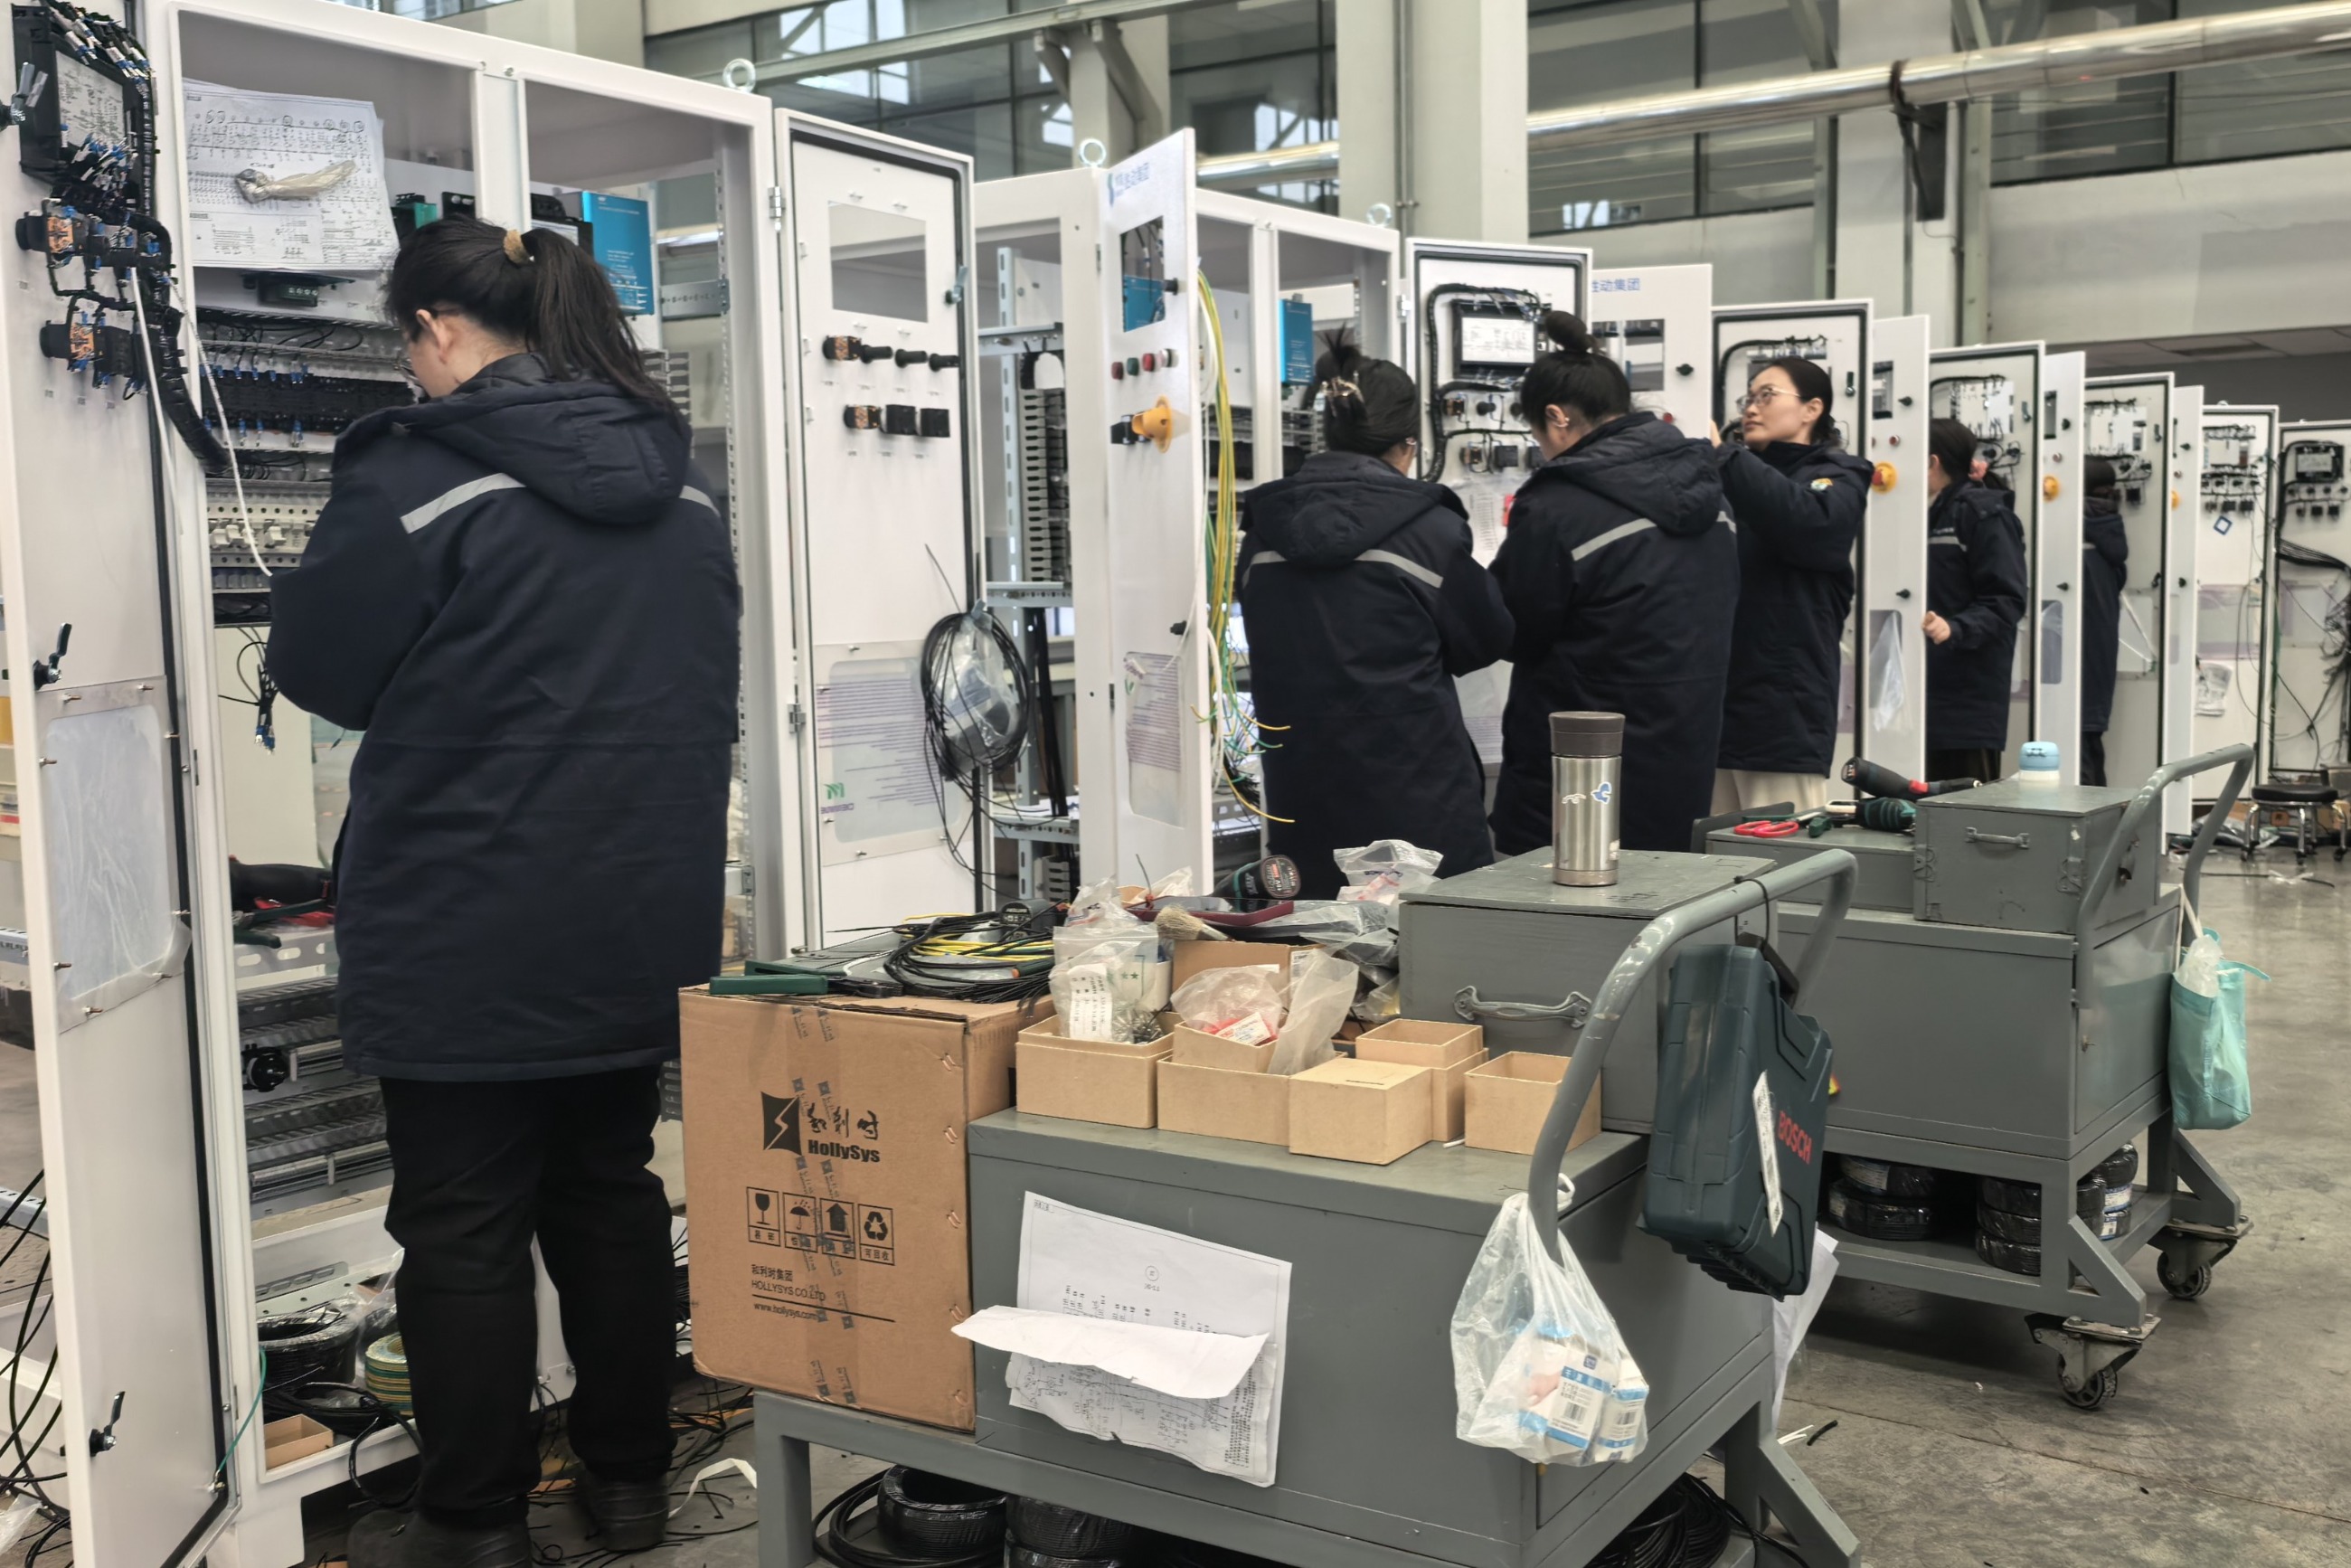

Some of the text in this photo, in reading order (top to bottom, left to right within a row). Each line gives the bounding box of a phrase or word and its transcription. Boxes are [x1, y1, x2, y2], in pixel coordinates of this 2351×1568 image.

[807, 1138, 881, 1163] HollySys
[1779, 1110, 1812, 1166] BOSCH
[751, 1263, 793, 1282] 和利时集团
